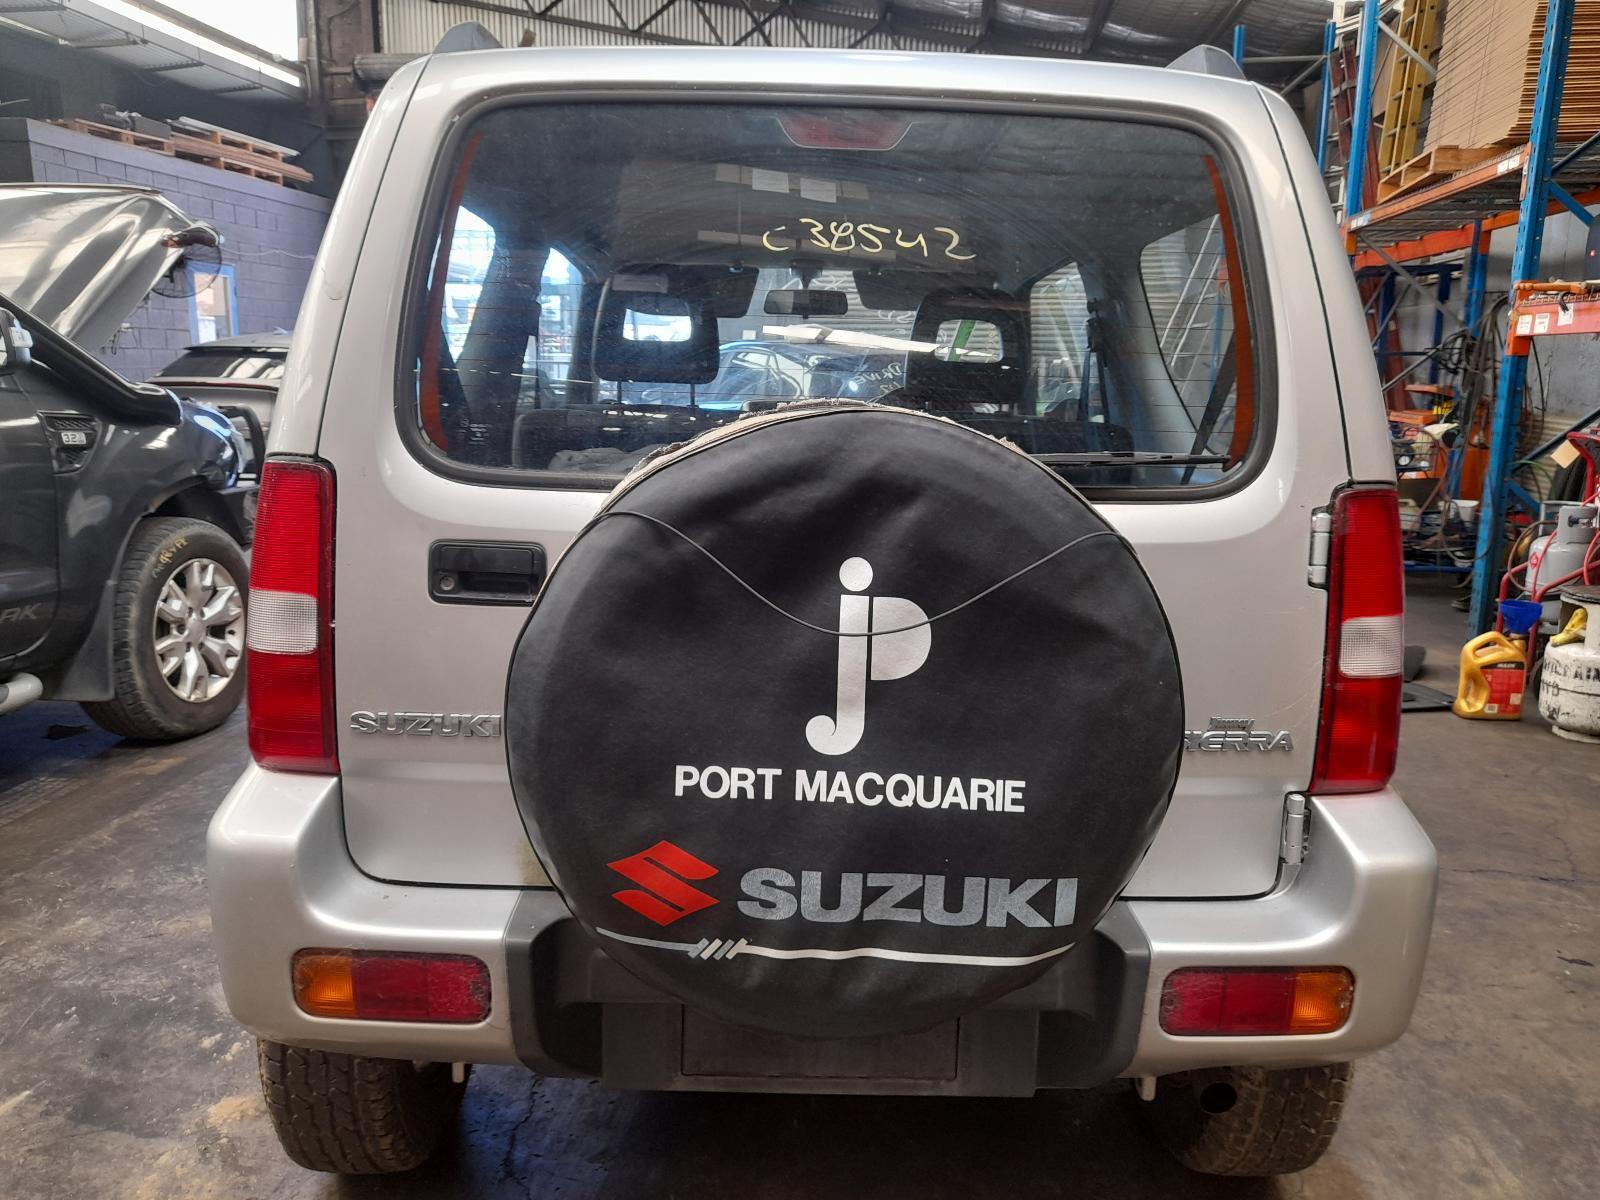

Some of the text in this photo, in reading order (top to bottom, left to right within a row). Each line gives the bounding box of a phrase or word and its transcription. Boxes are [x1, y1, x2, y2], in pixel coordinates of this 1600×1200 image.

[350, 710, 501, 737] SUZUKI
[674, 764, 1026, 813] PORT MACQUARIE
[736, 867, 1079, 928] SUZUKI
